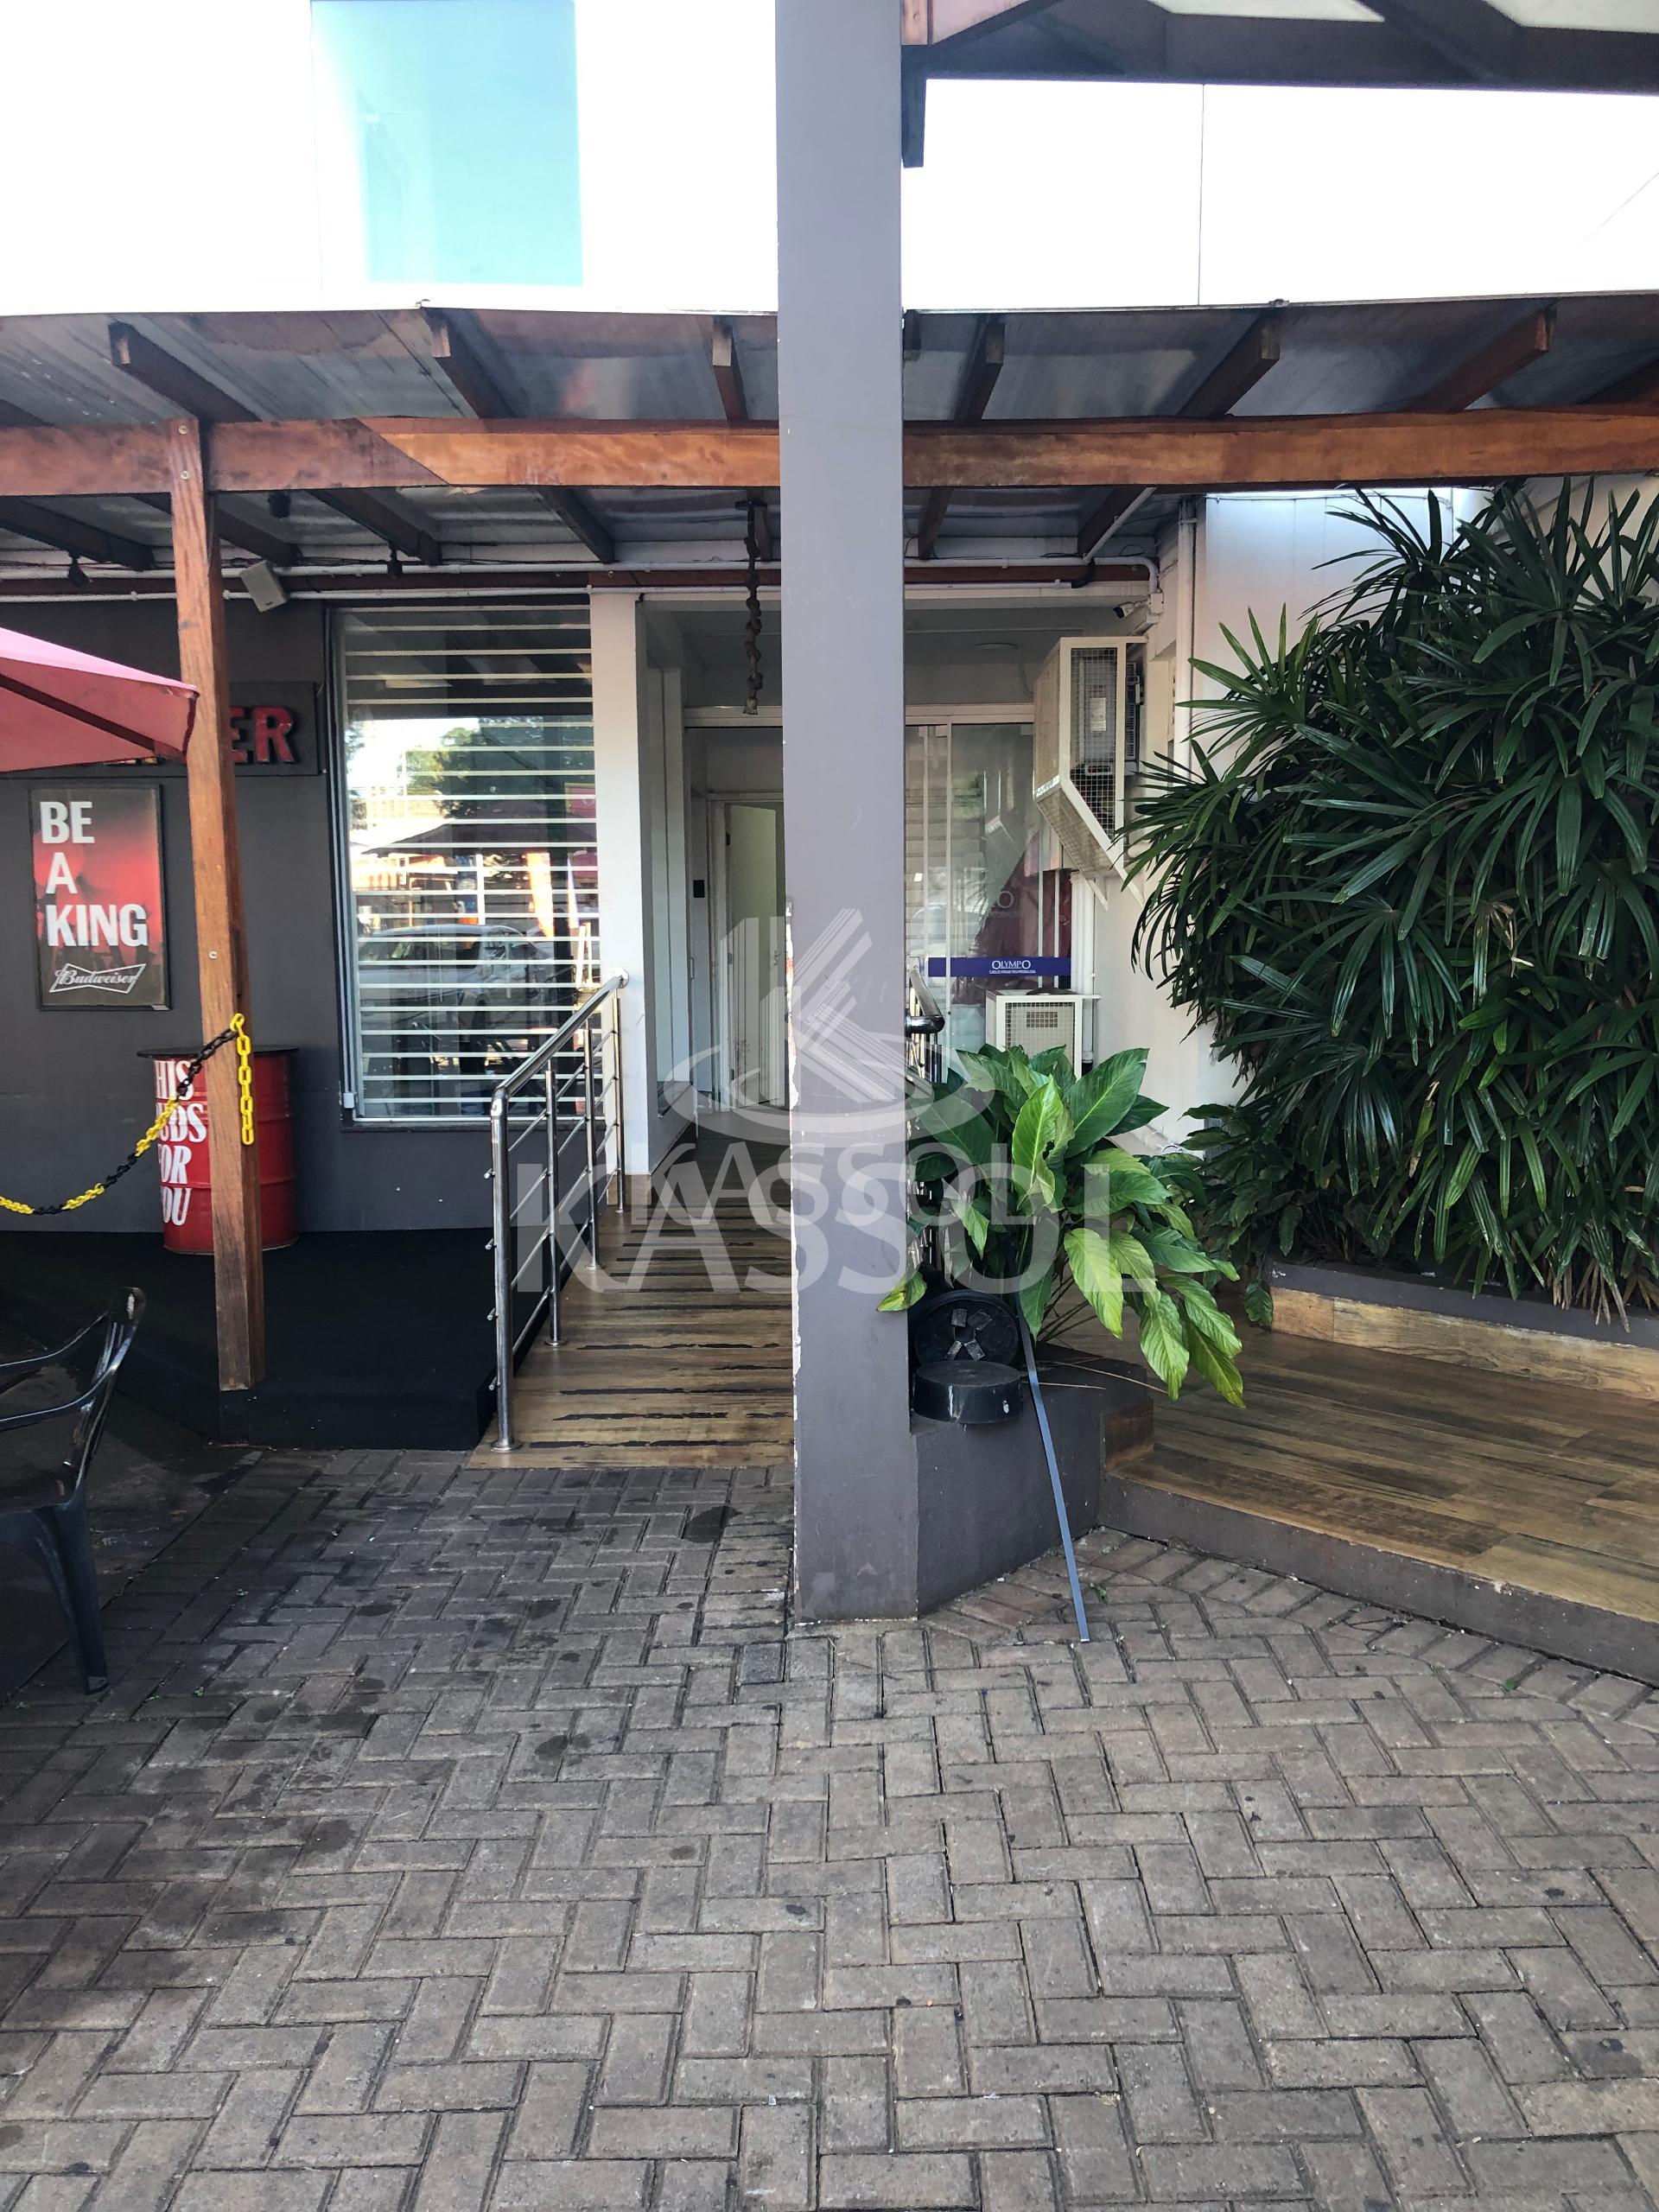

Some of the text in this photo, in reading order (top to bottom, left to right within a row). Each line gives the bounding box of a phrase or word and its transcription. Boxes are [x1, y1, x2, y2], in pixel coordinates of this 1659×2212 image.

[41, 802, 95, 843] BE
[45, 852, 78, 894] A
[47, 904, 148, 946] KING
[54, 969, 138, 985] Budweiser
[992, 960, 1032, 969] OLYMPO
